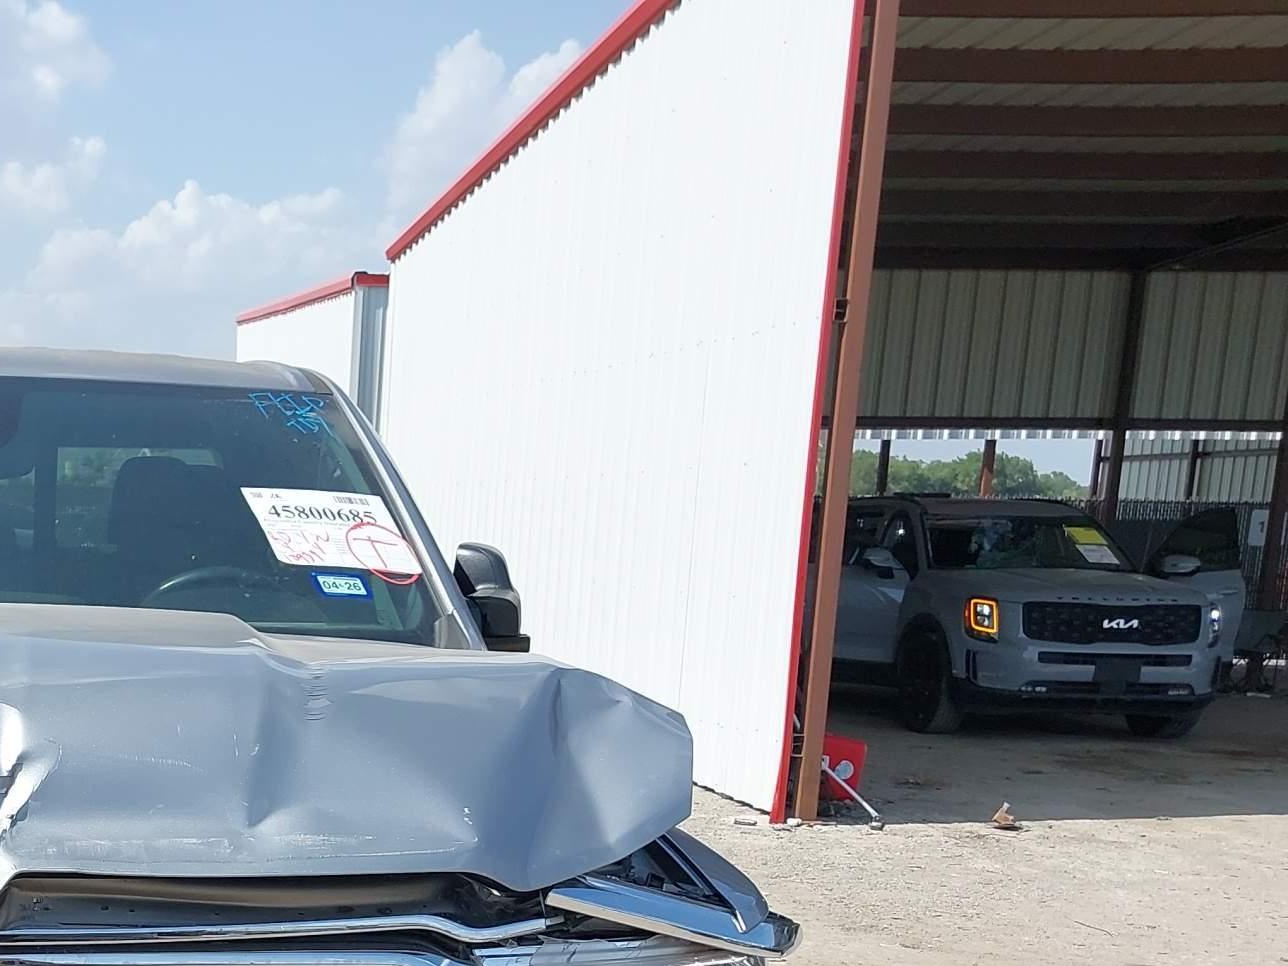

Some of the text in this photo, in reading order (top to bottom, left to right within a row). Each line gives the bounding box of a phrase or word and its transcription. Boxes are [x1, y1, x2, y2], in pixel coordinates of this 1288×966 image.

[267, 504, 378, 524] 45800685
[322, 580, 362, 591] 04 26
